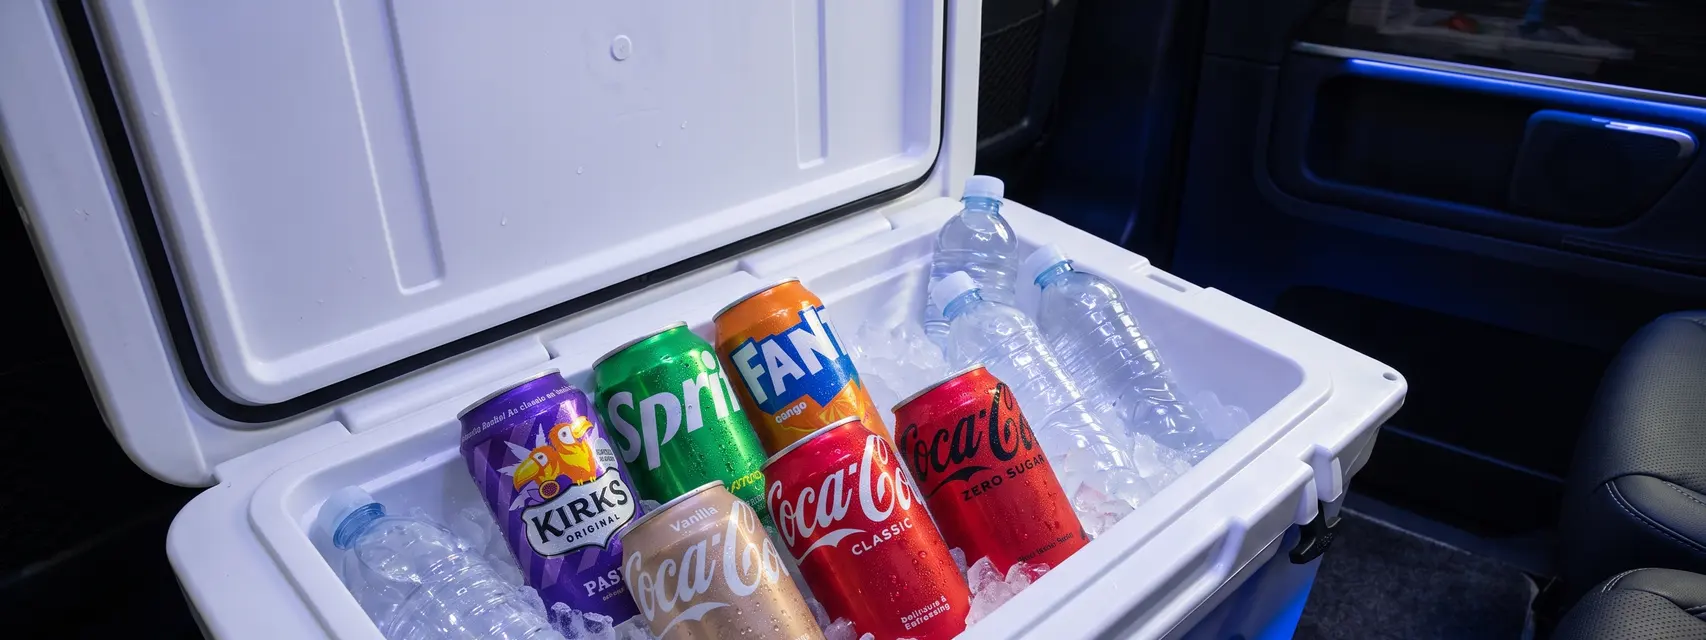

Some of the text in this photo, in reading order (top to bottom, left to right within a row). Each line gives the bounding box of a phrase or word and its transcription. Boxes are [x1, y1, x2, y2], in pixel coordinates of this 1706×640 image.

[901, 382, 1040, 482] Coca-Co
[767, 434, 923, 548] Coca-Co
[961, 454, 1045, 501] ZERO SUGAR
[531, 479, 628, 544] KIRKS
[566, 513, 620, 543] ORIGINAL
[669, 505, 720, 532] Vanilla
[851, 517, 913, 556] CLASSIC
[583, 567, 621, 597] PAS
[625, 500, 790, 622] Coca-Co
